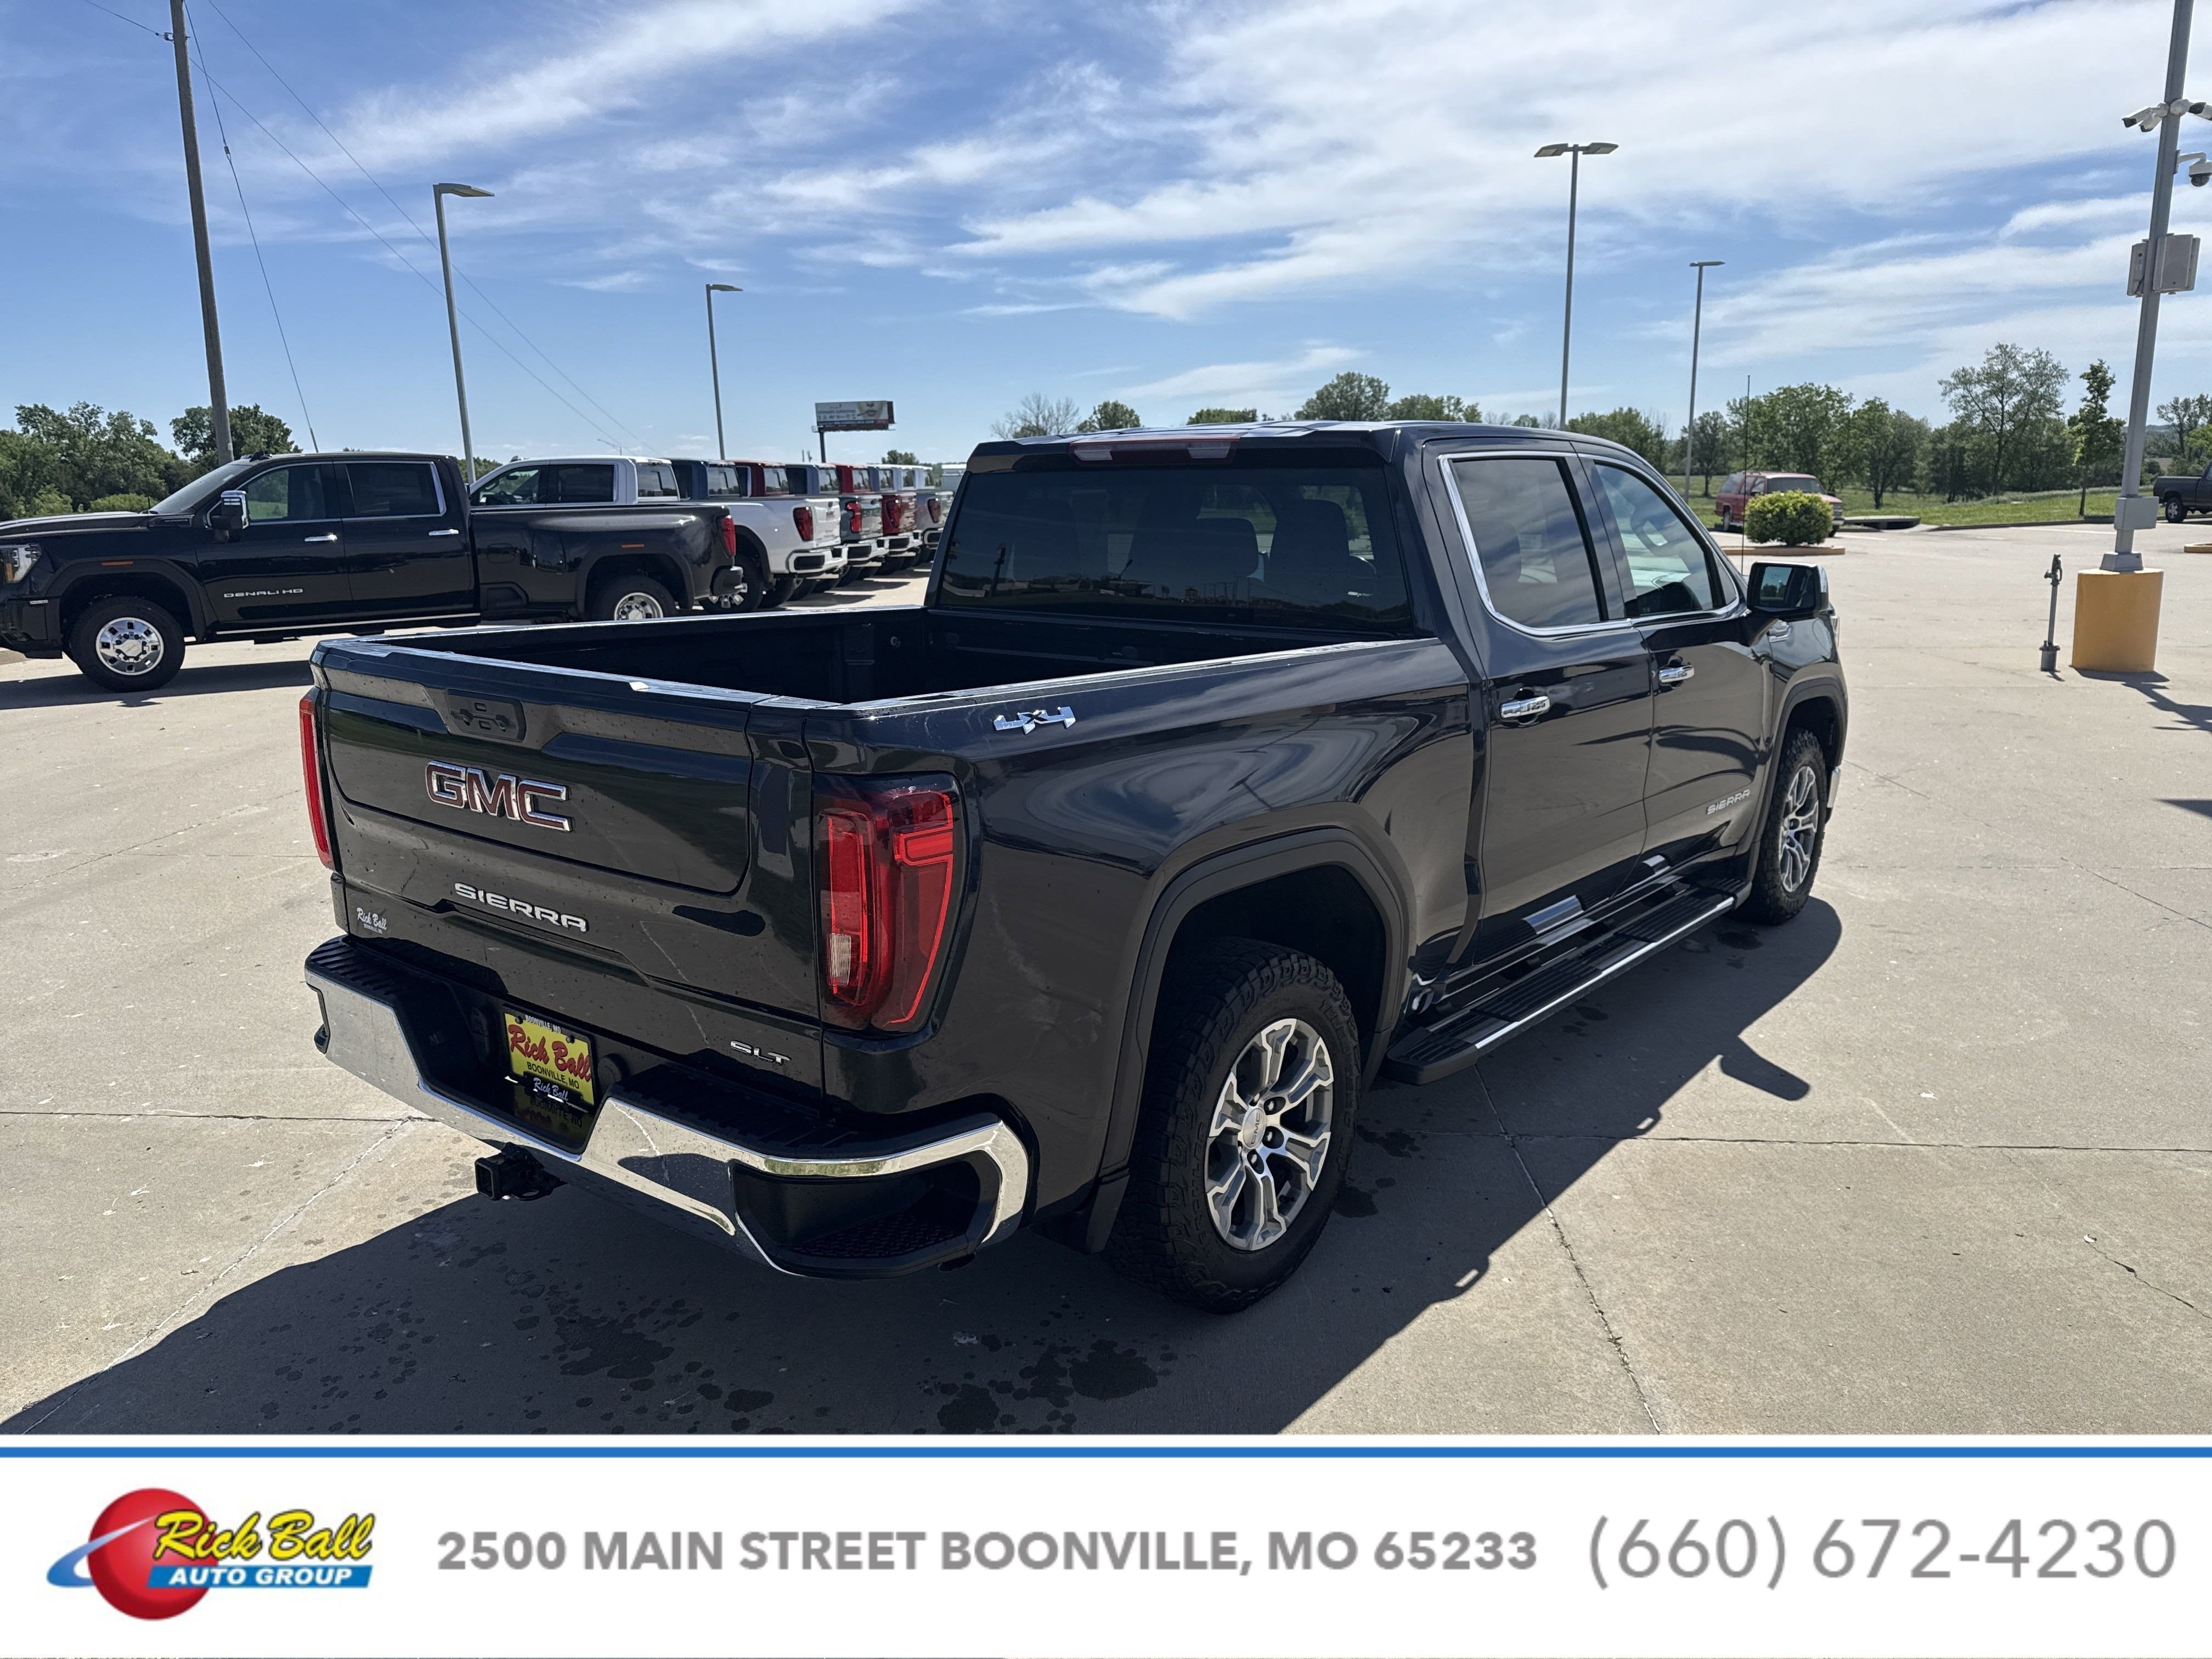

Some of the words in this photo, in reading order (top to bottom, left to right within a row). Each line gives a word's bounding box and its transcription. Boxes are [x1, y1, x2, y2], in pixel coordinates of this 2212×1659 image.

[223, 590, 279, 598] DENALI
[425, 760, 573, 832] GMC
[1707, 789, 1751, 815] SIERRA
[357, 907, 372, 925] Rick
[373, 913, 387, 930] Ball
[454, 882, 589, 933] SIERRA
[553, 1025, 561, 1034] MO
[508, 1024, 550, 1065] Rick
[551, 1041, 591, 1082] Ball
[730, 1040, 791, 1065] SLT
[527, 1061, 567, 1086] BOONVILLE,
[568, 1077, 579, 1089] MO
[533, 1077, 551, 1094] Rick
[551, 1085, 569, 1101] Ball
[1251, 1112, 1261, 1144] GMC
